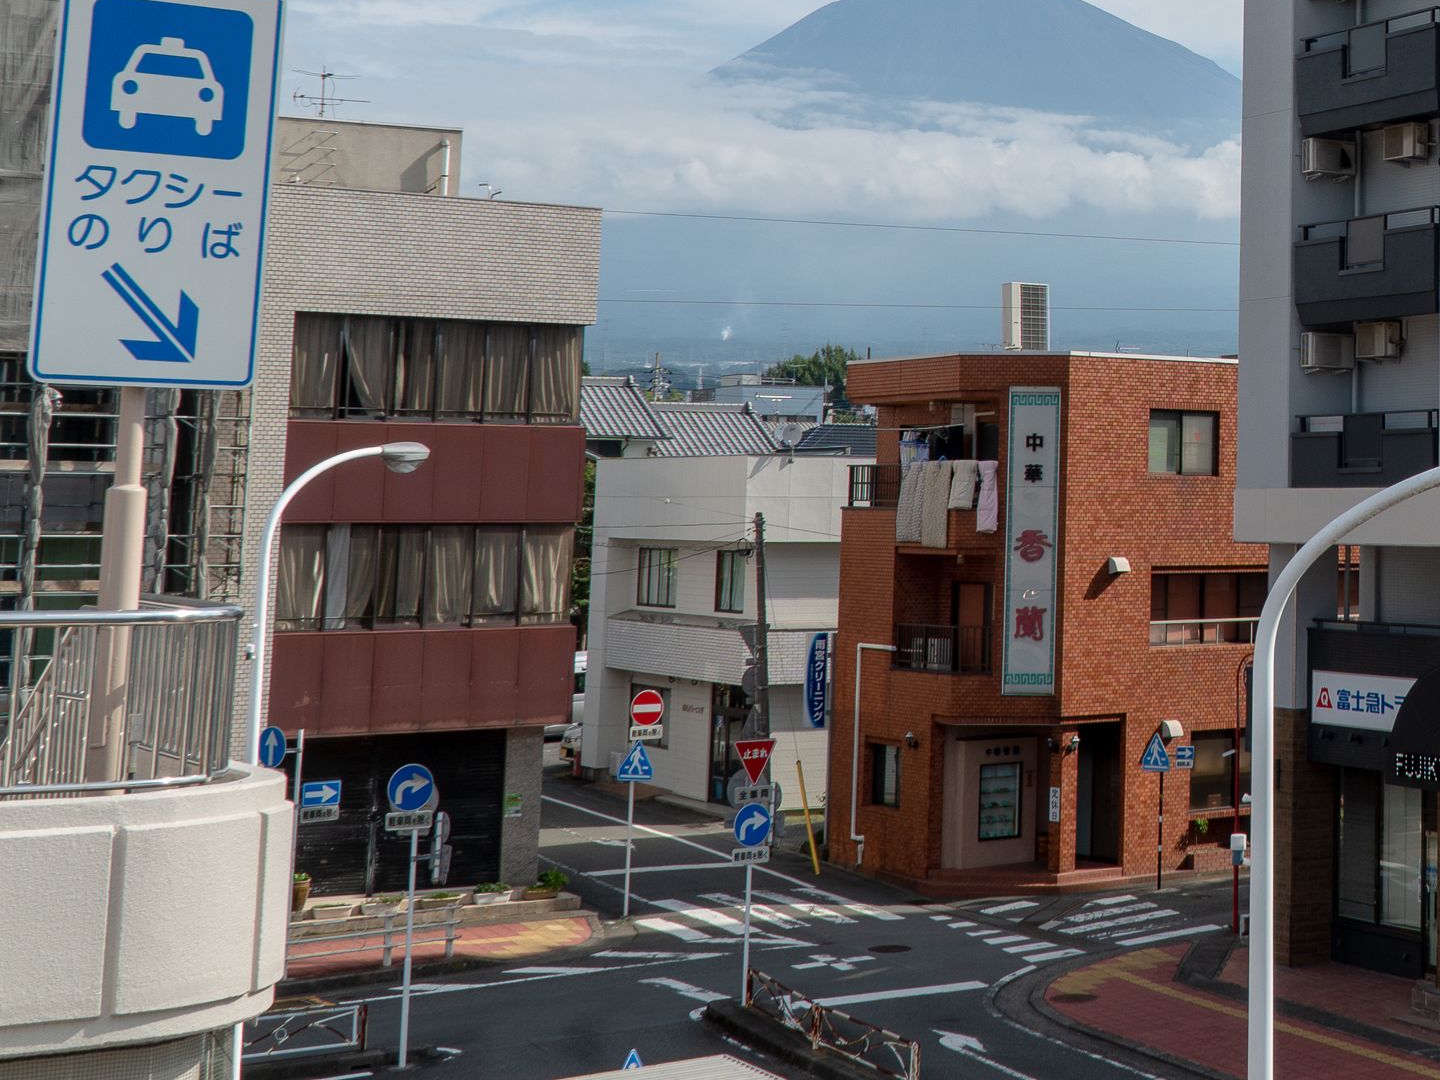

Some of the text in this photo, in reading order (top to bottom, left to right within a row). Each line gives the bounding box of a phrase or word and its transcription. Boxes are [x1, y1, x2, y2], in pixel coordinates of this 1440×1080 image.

[75, 164, 243, 209] タクシー
[67, 213, 243, 259] のりば
[1013, 432, 1053, 641] 中華 香蘭
[743, 748, 768, 760] 止まれ
[738, 788, 769, 801] 全車両
